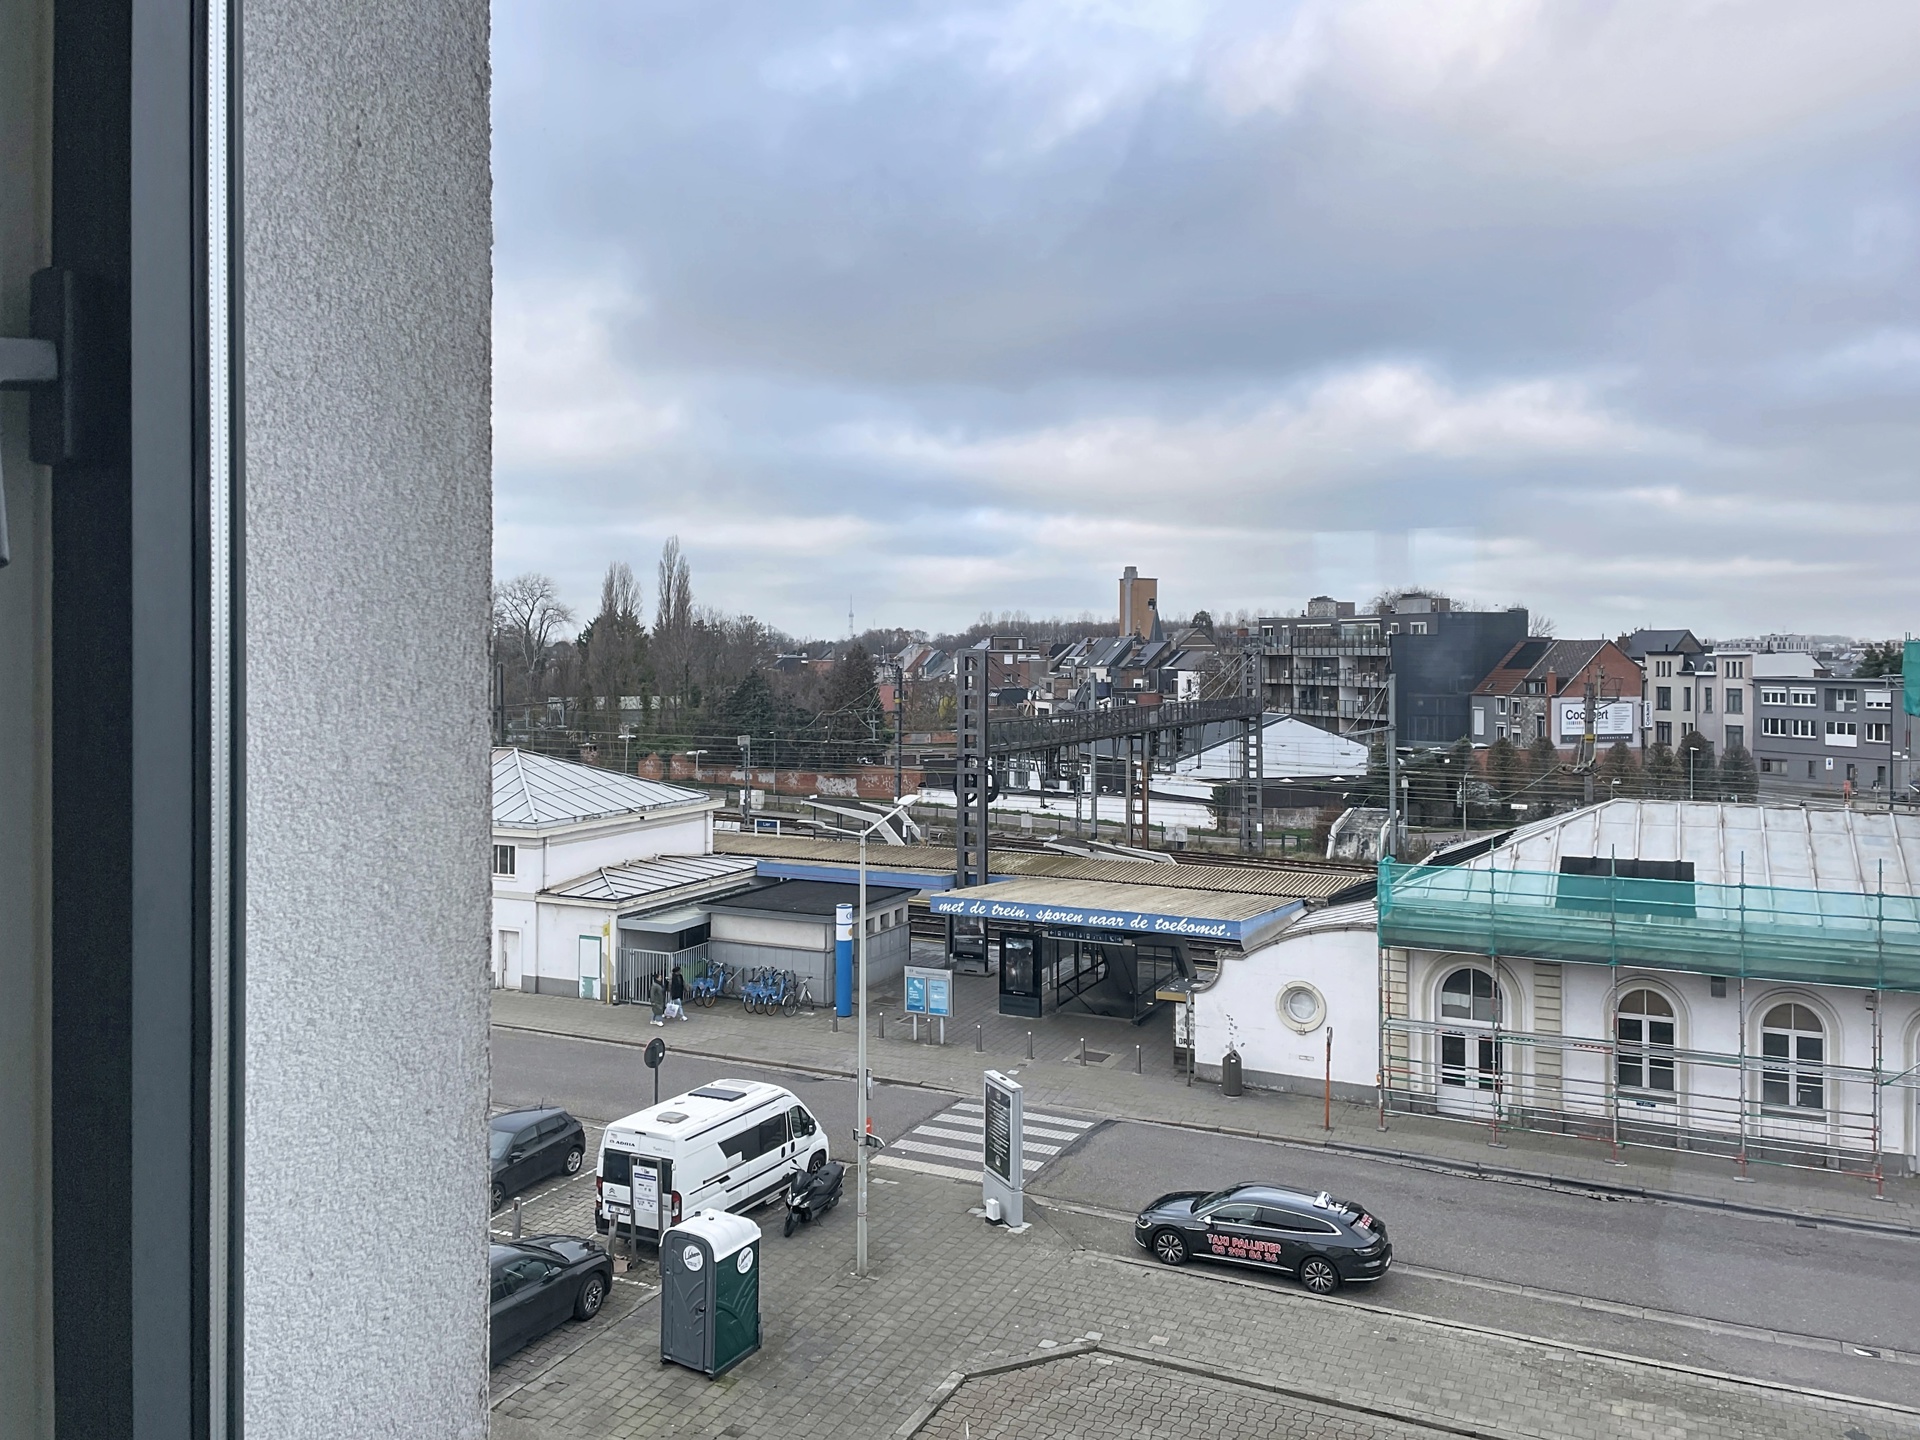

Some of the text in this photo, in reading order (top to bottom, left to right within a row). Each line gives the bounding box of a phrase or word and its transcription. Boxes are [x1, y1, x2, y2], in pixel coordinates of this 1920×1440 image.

[1565, 709, 1609, 720] Cocert
[939, 900, 1231, 937] met de trein, sporen naar de toekomst.
[1206, 1234, 1282, 1254] TAXI PALLIETER
